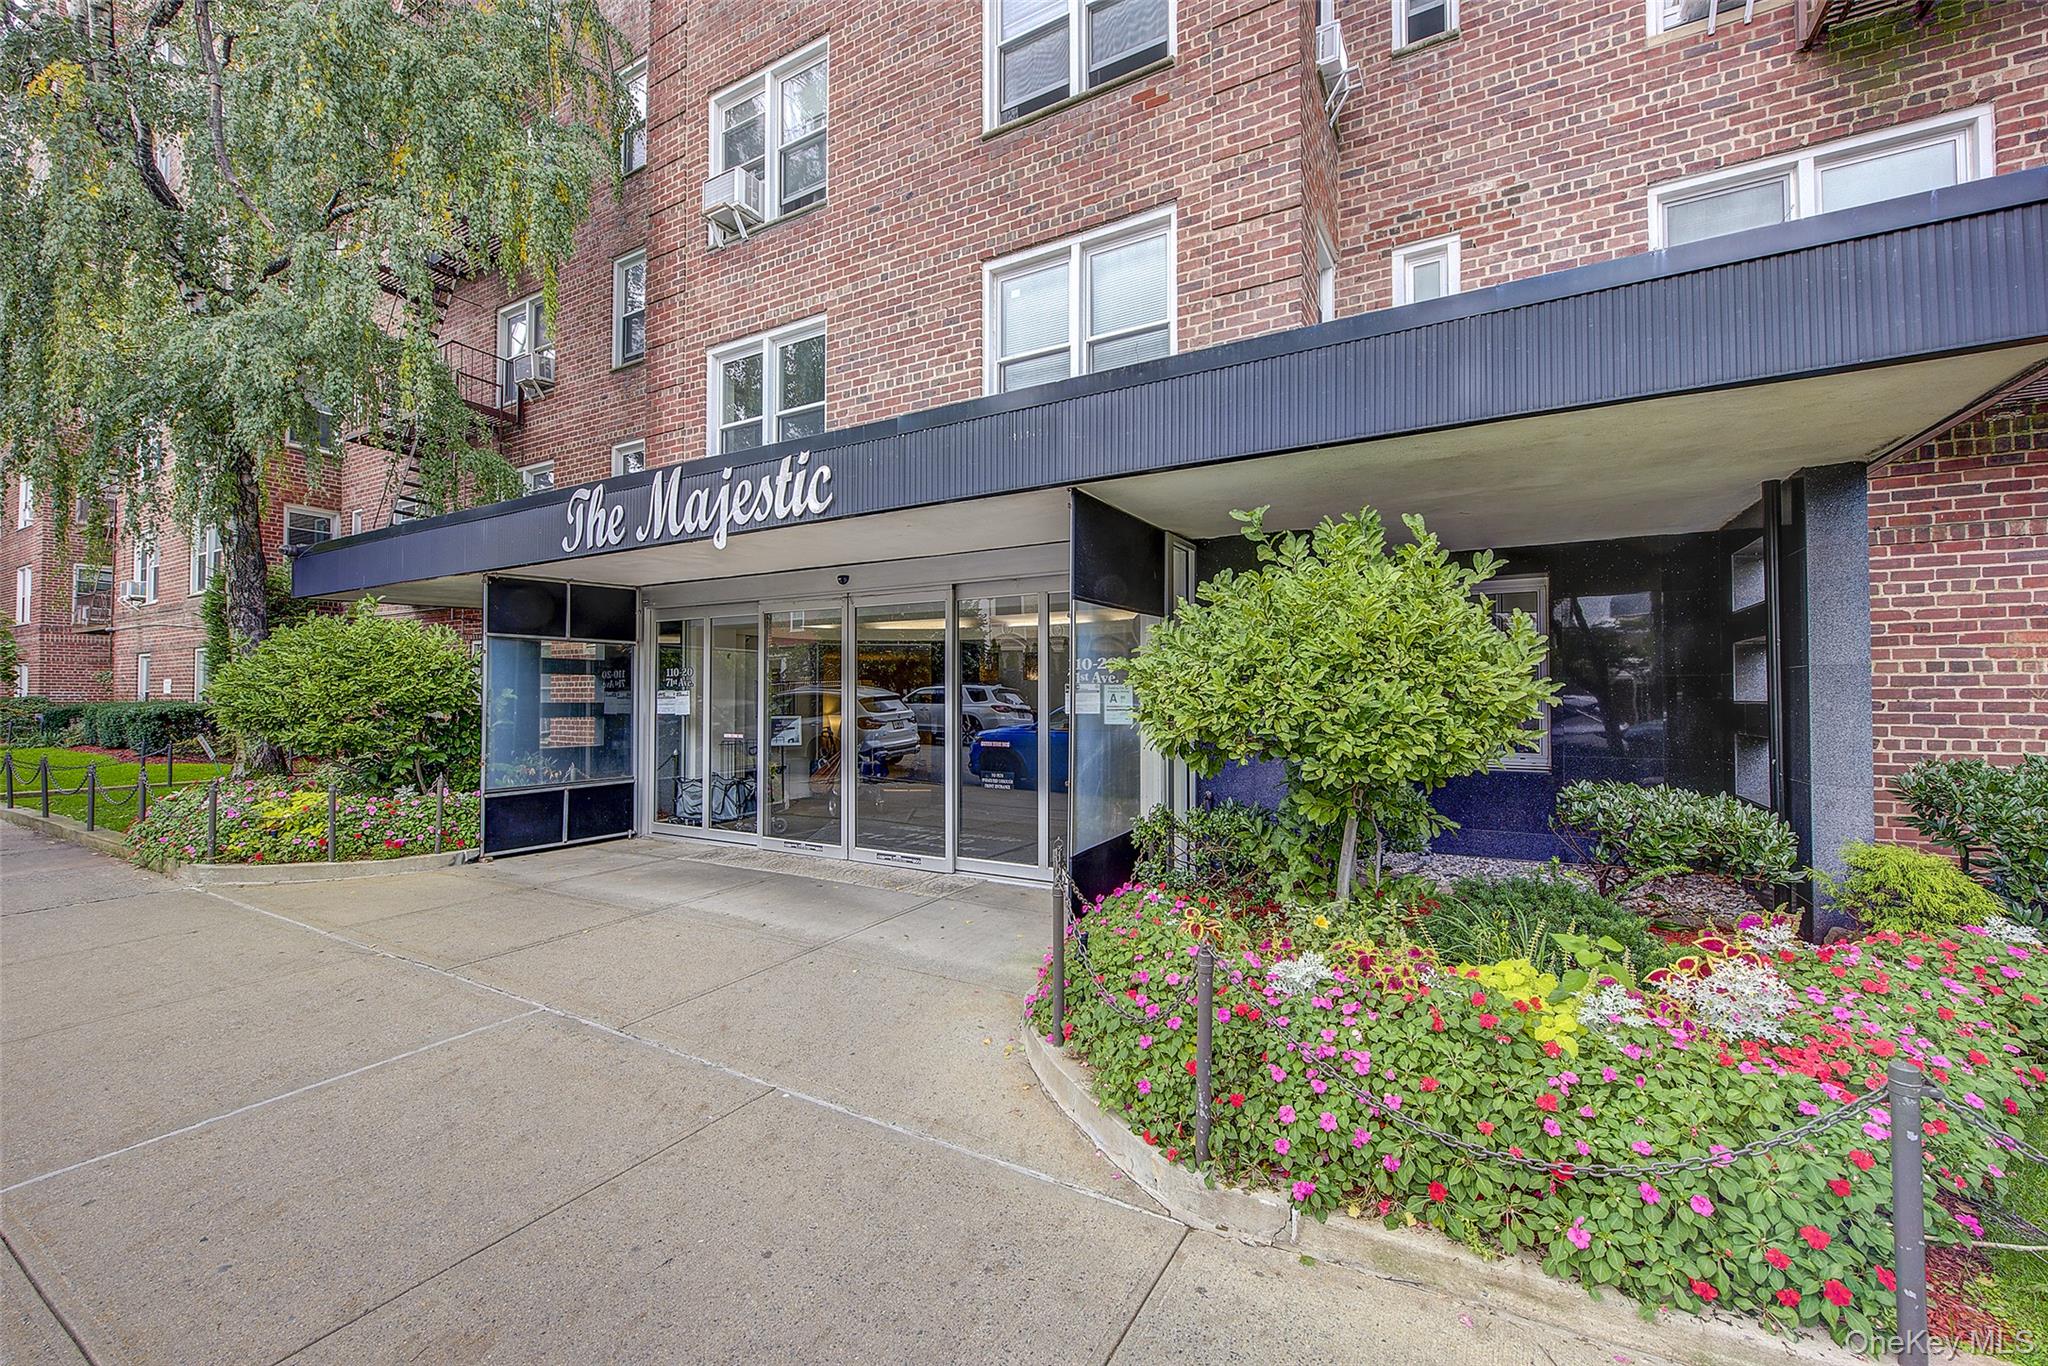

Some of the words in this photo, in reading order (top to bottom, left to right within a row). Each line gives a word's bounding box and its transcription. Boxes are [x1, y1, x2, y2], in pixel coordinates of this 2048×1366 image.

[561, 483, 626, 552] The
[636, 450, 833, 550] Majestic
[1069, 657, 1117, 671] 10-2
[666, 668, 693, 677] 110-20
[1067, 671, 1088, 684] 1st
[1092, 671, 1119, 684] Ave.
[1109, 693, 1118, 703] A
